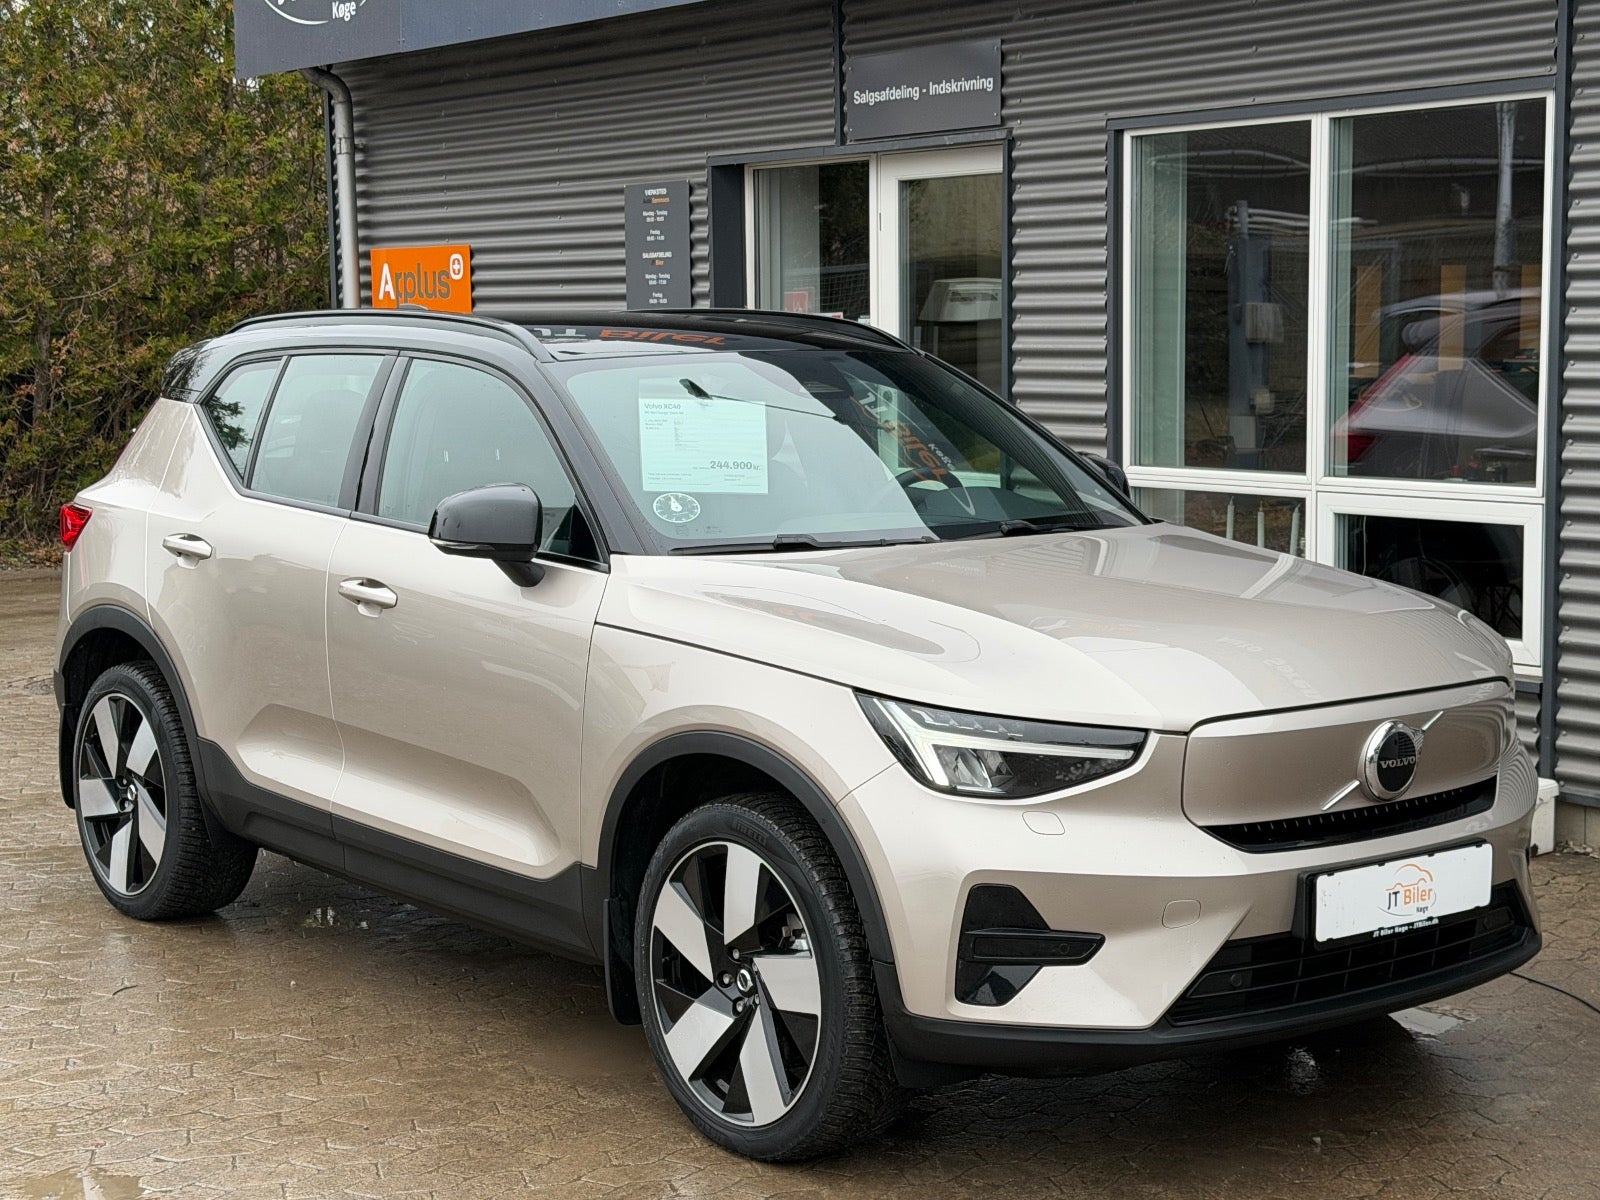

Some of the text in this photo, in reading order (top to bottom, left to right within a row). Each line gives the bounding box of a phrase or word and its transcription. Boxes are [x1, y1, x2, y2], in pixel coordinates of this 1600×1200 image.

[332, 1, 356, 22] Køge
[853, 84, 920, 106] Salgsafdeling
[929, 75, 994, 95] Indskrivning
[644, 402, 663, 410] Volvo
[710, 460, 753, 470] 244.900
[1380, 756, 1416, 769] VOLVO
[1387, 886, 1432, 910] JT Biler
